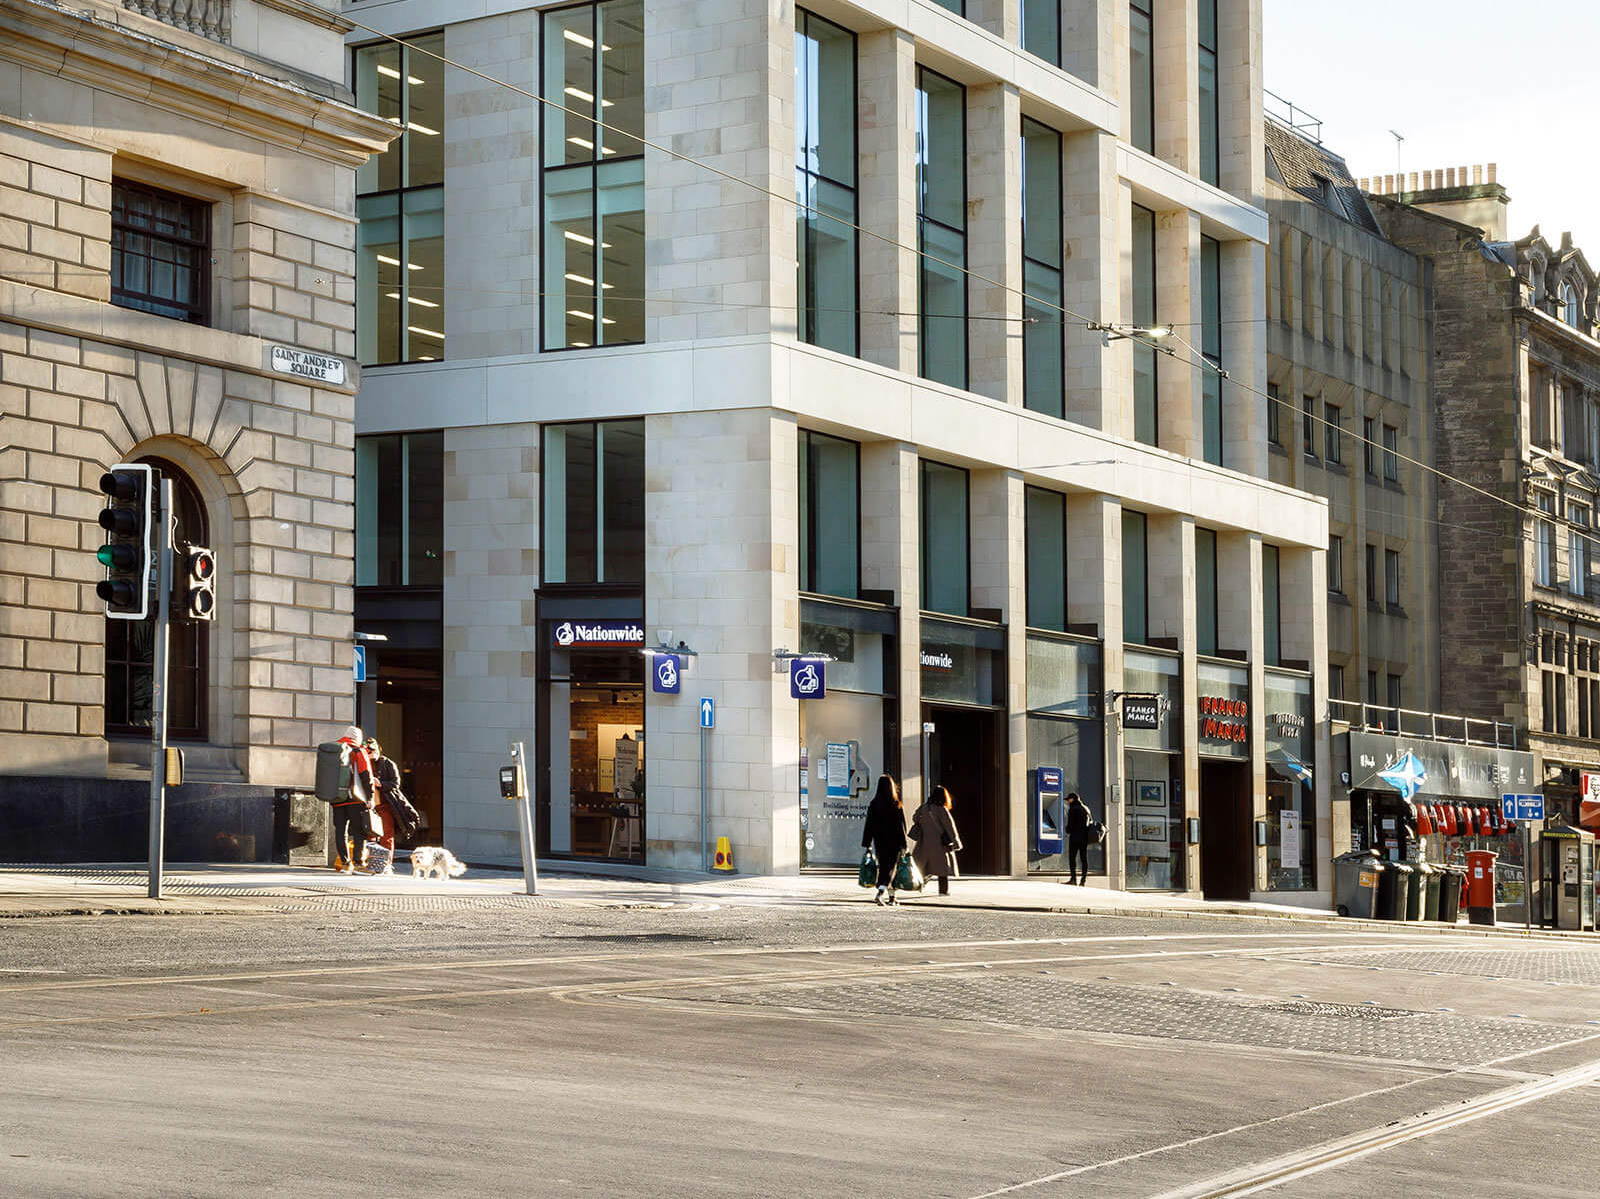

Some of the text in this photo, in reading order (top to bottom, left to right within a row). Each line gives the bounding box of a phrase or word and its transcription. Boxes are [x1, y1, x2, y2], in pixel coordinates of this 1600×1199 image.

[275, 348, 341, 370] SAINT ANDREW
[290, 362, 326, 379] SQUARE
[575, 625, 644, 641] Nationwide
[1126, 705, 1156, 715] FRANCO
[1202, 696, 1248, 718] FRANCO
[1127, 713, 1157, 723] MANCA
[1203, 716, 1247, 743] MANCA
